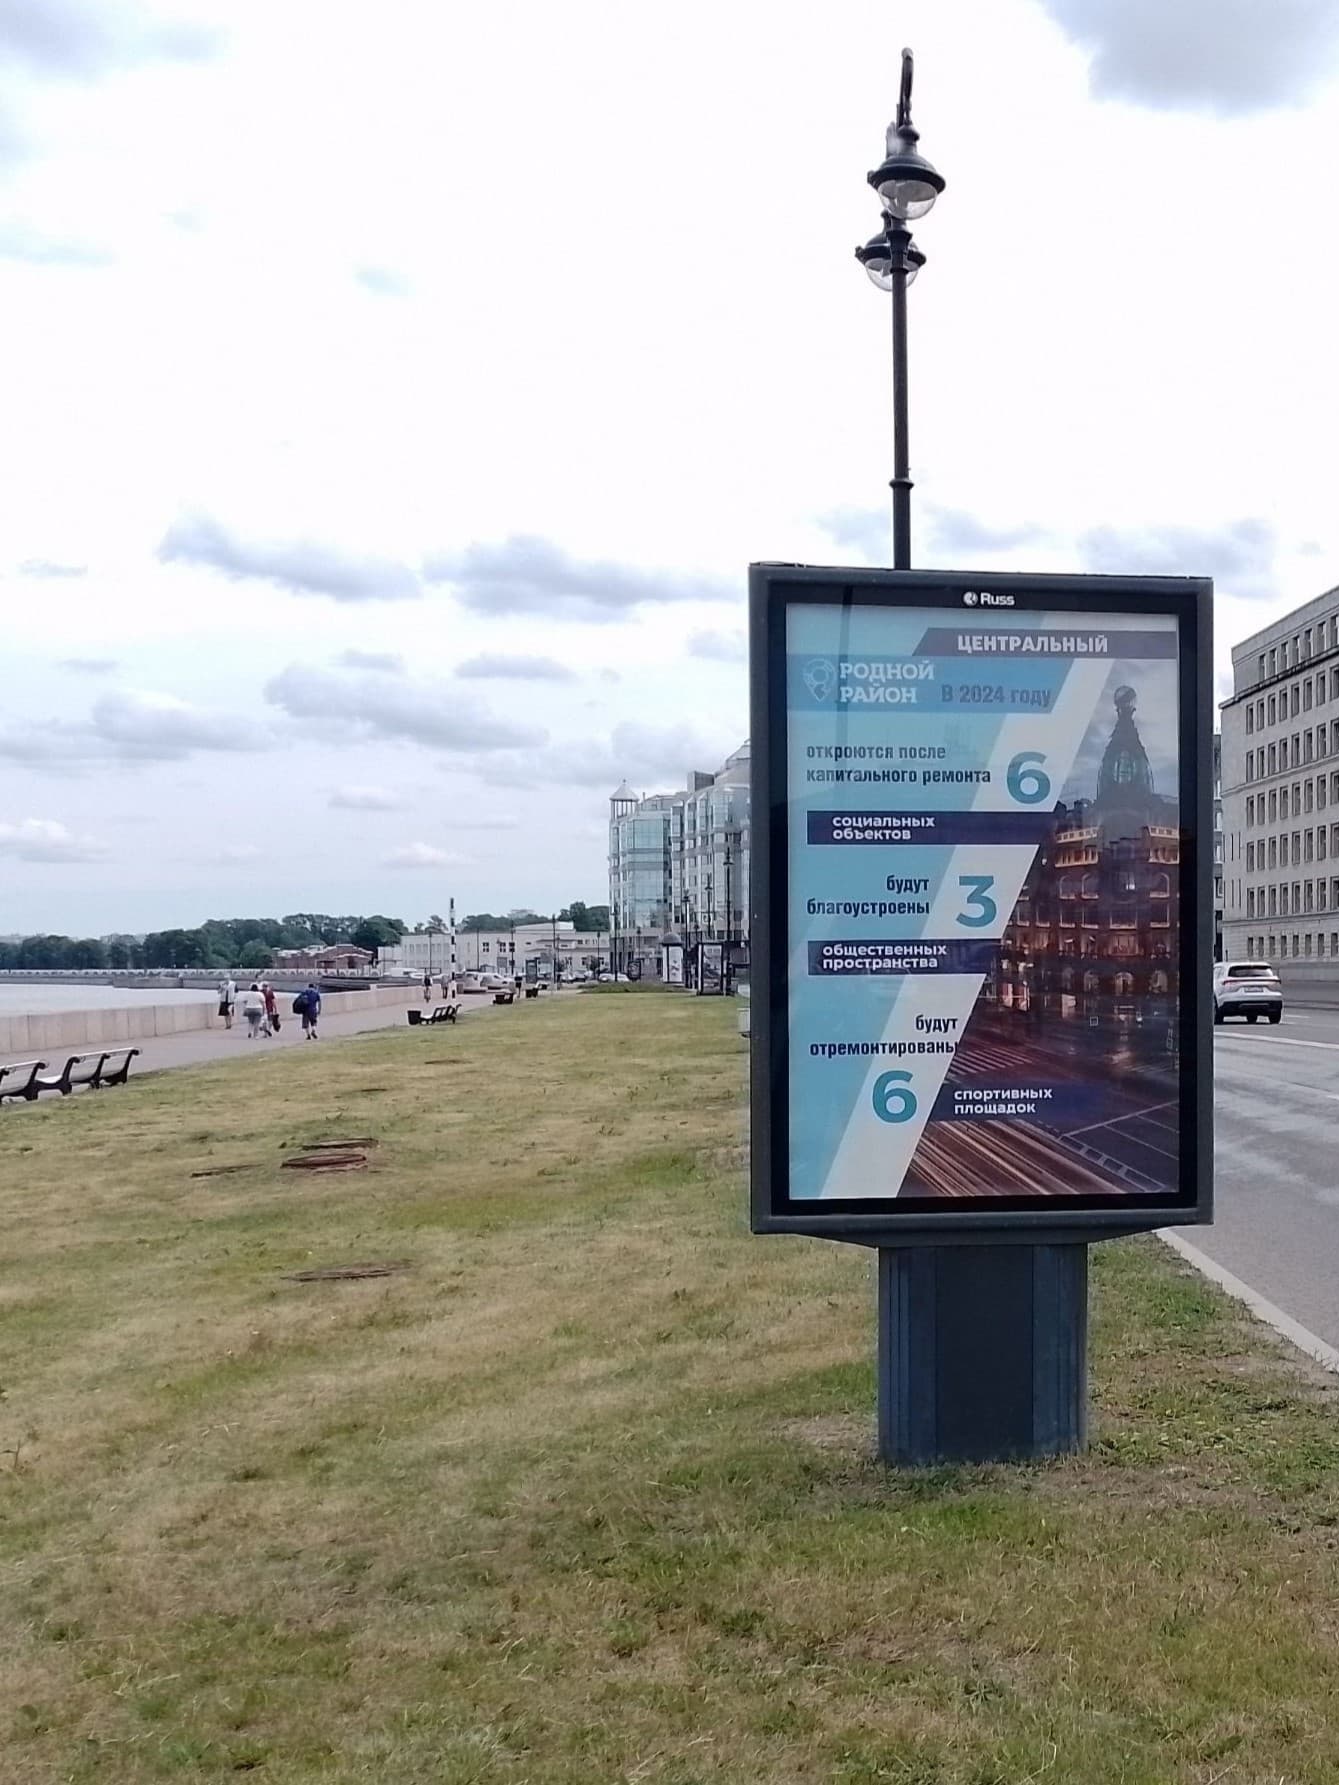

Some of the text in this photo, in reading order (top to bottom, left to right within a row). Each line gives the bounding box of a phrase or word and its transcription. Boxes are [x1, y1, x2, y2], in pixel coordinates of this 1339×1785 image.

[980, 593, 1015, 606] Russ
[957, 634, 1108, 653] ЦЕНТРАЛЬНЫЙ
[840, 660, 935, 682] РОДНОЙ
[840, 685, 918, 704] РАЙОН
[959, 685, 1004, 703] 2024
[1010, 690, 1050, 708] году
[807, 745, 946, 760] откроются после
[807, 768, 991, 785] капитального ремонта
[1006, 751, 1051, 803] 6
[833, 815, 936, 829] социальных
[833, 828, 911, 840] объектов
[887, 876, 929, 893] будут
[807, 899, 930, 916] благоустроены
[956, 875, 997, 927] 3
[823, 943, 947, 958] общественных
[823, 956, 938, 969] пространства
[915, 1016, 958, 1033] будут
[810, 1041, 958, 1058] отремонтированы
[871, 1070, 917, 1123] 6
[954, 1087, 1052, 1102] спортивных
[954, 1101, 1036, 1115] площадок
